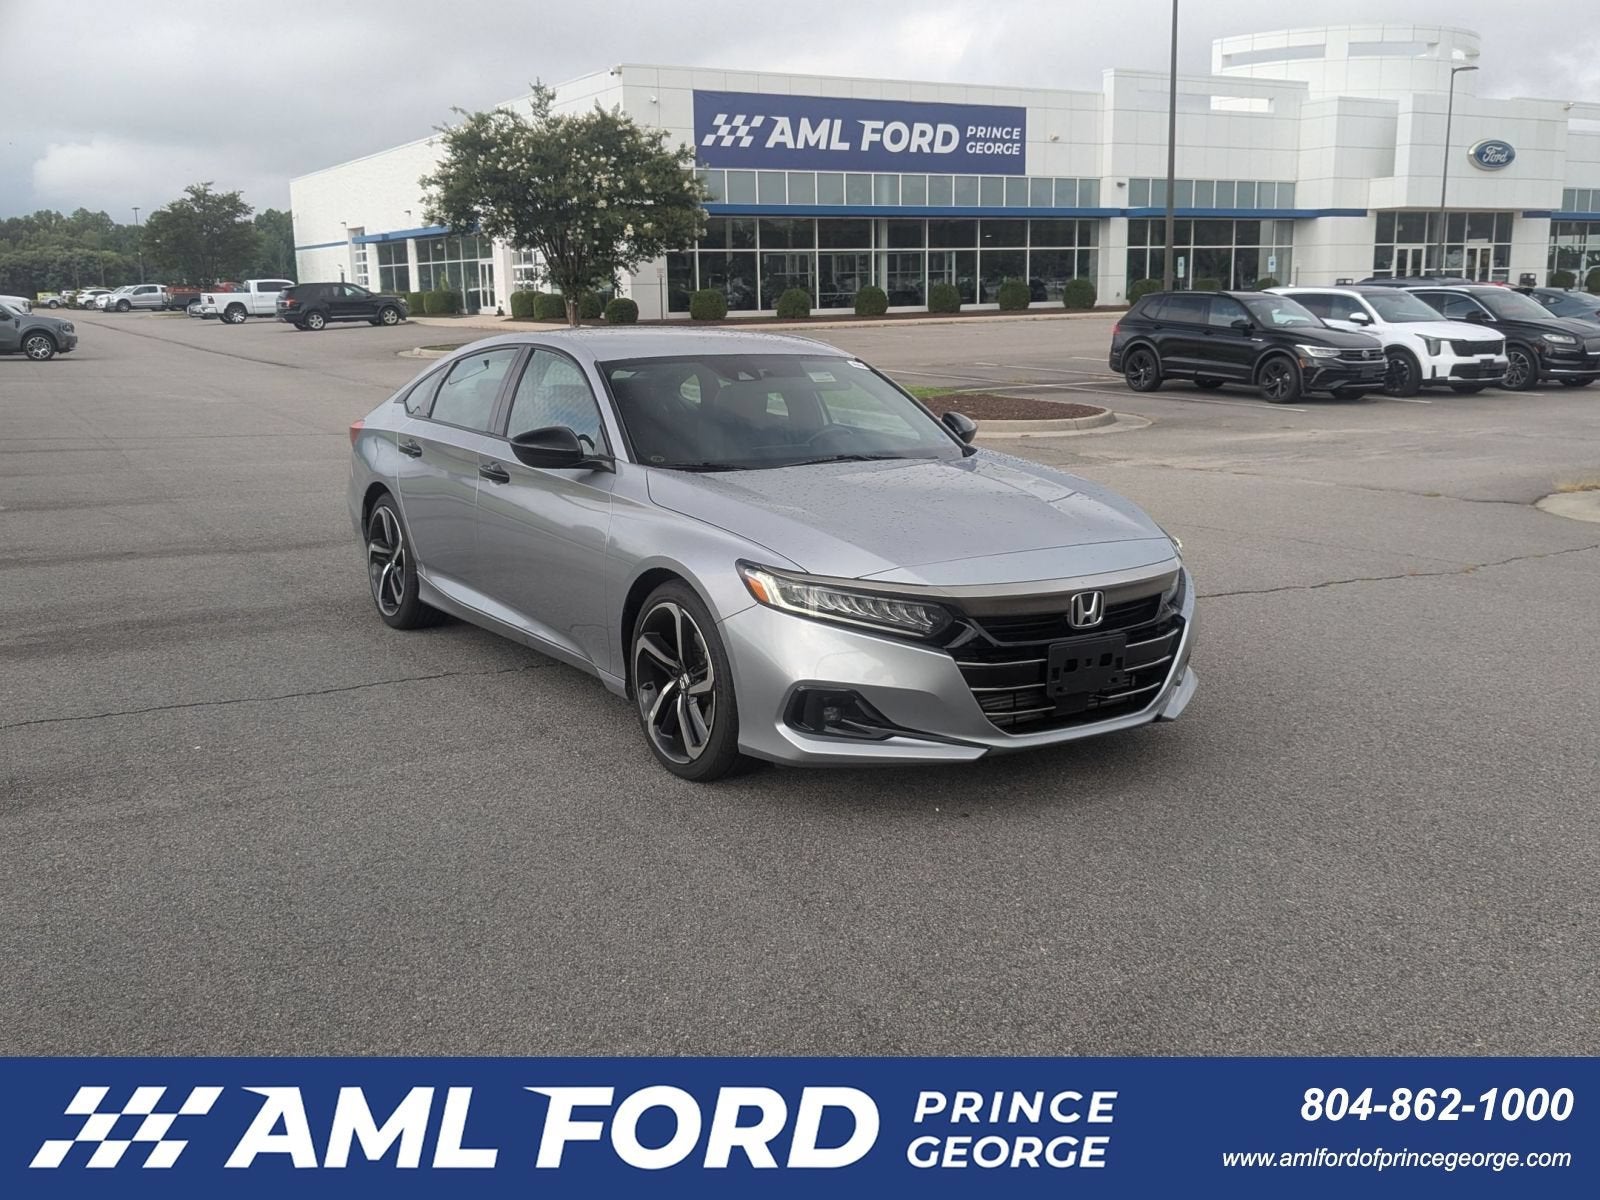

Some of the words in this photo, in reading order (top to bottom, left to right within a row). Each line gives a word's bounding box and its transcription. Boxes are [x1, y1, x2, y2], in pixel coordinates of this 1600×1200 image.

[765, 116, 850, 150] AML
[856, 120, 960, 154] FORD
[966, 126, 1021, 139] PRINCE
[966, 141, 1020, 155] GEORGE
[1482, 145, 1508, 163] Ford
